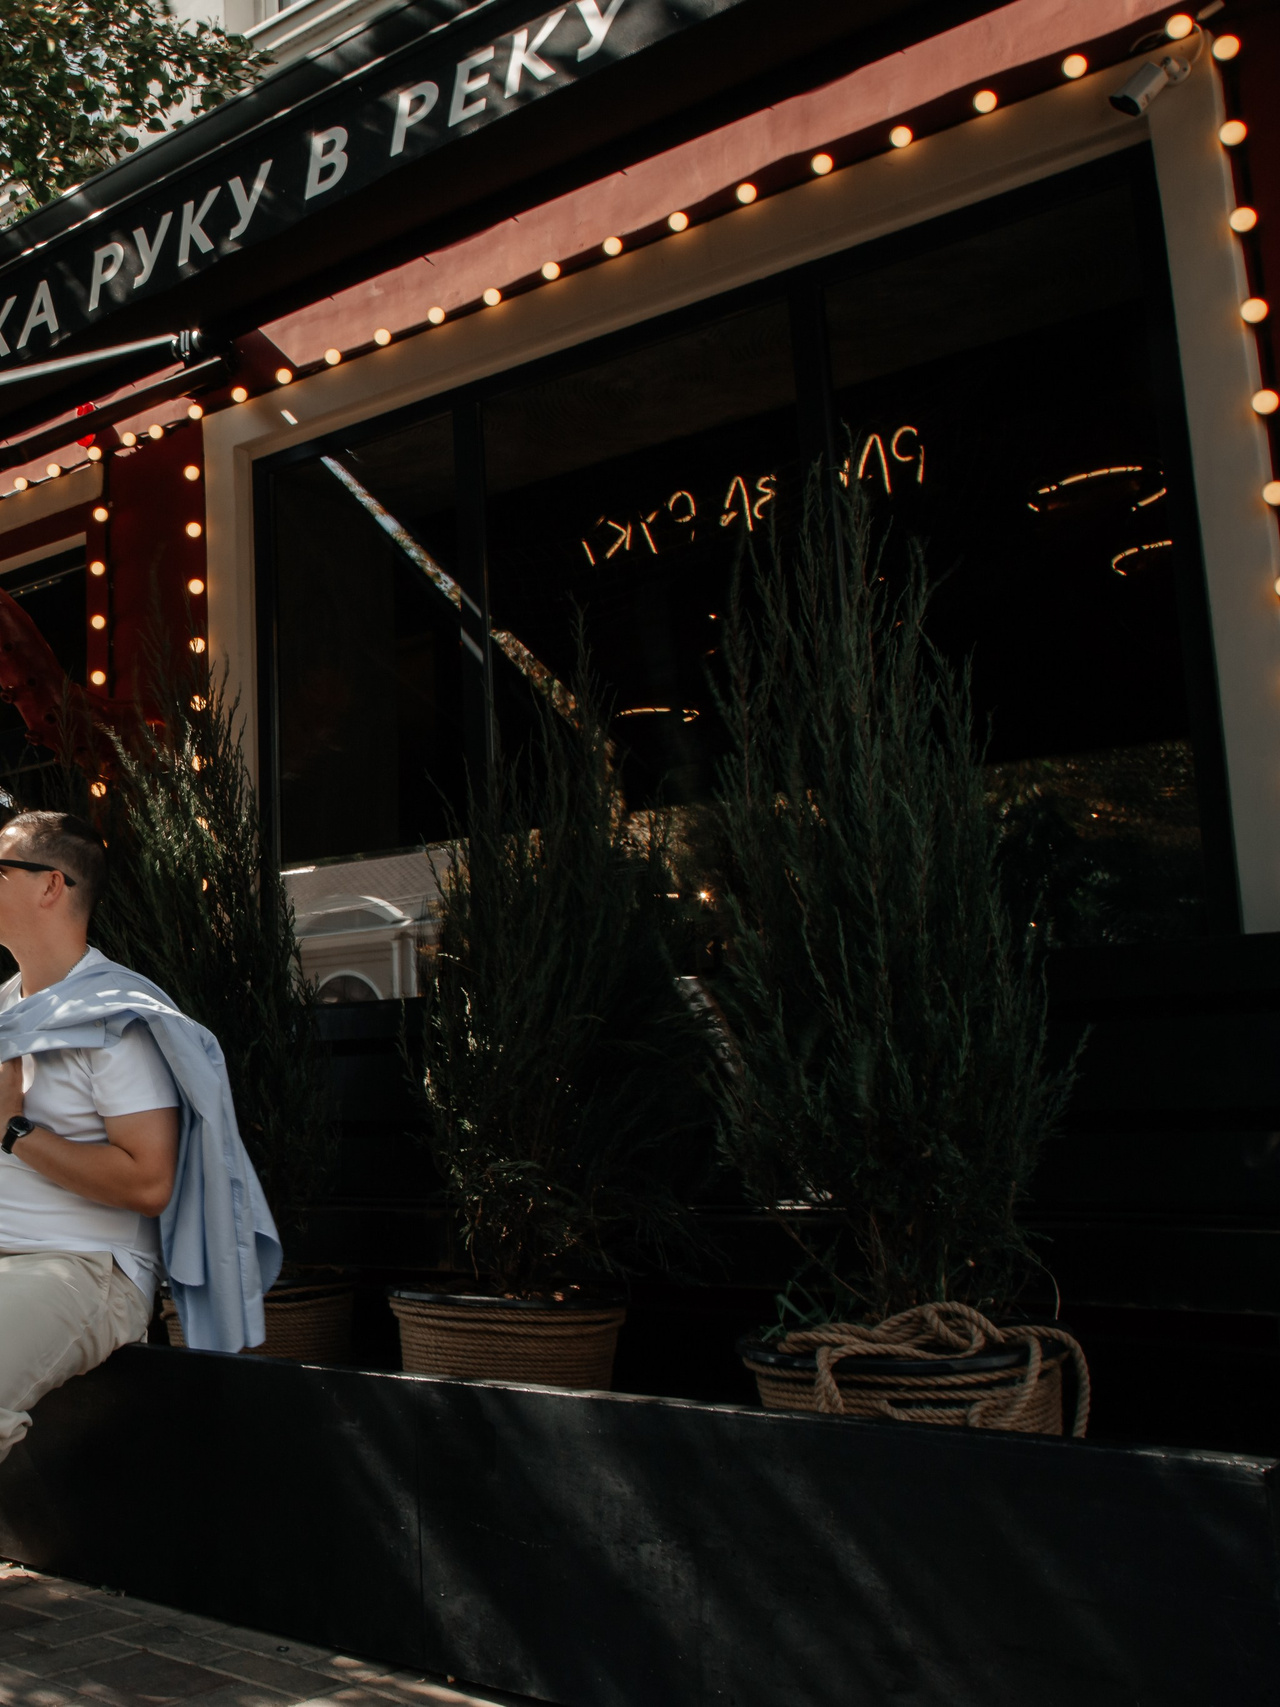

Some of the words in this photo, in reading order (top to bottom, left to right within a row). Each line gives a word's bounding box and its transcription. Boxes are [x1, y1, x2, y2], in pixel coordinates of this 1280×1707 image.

[88, 159, 273, 312] РУКУ
[304, 126, 348, 200] В
[390, 0, 625, 158] РЕКУ
